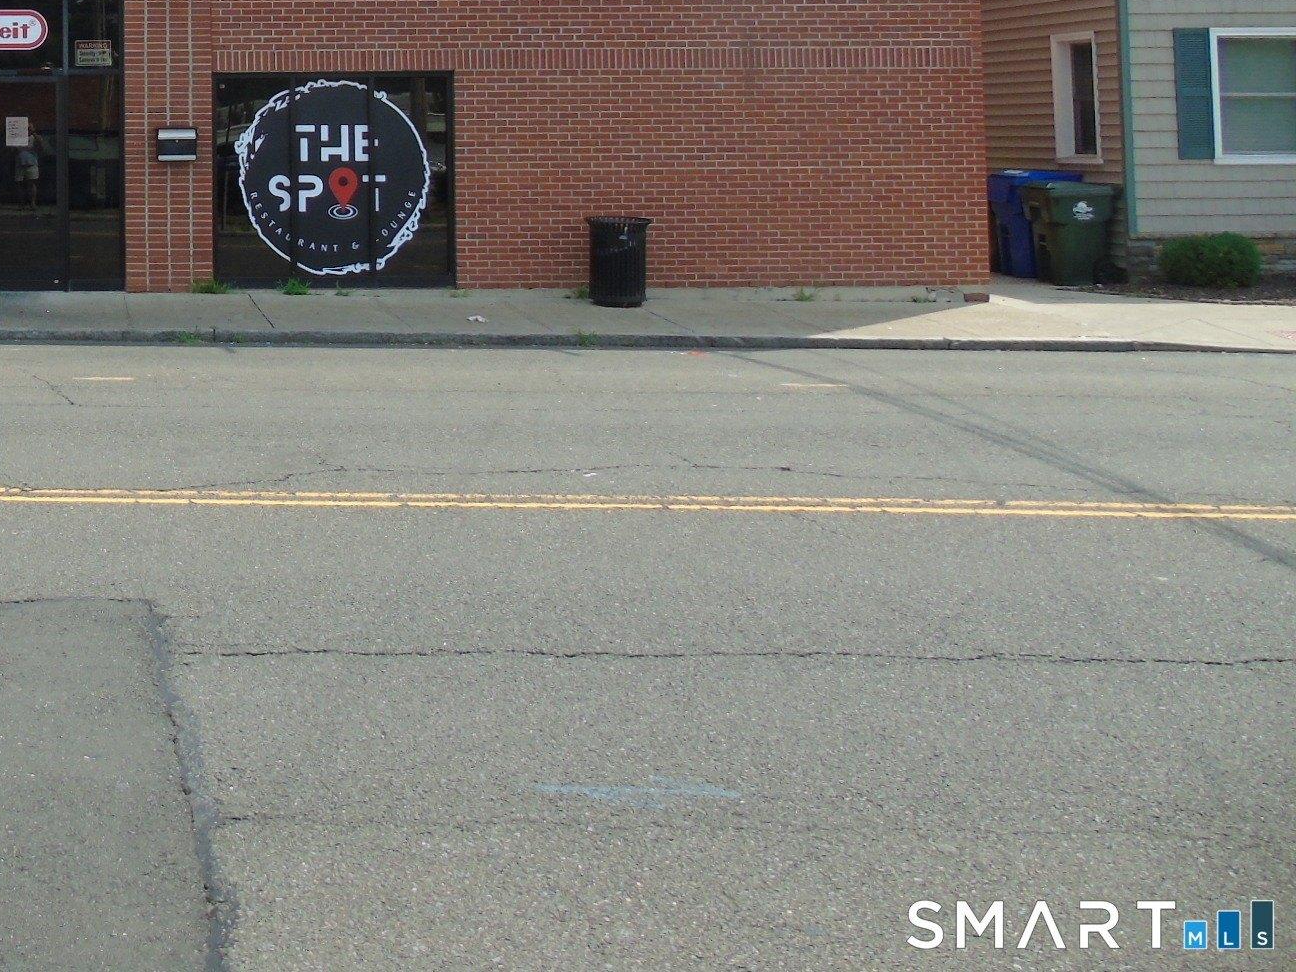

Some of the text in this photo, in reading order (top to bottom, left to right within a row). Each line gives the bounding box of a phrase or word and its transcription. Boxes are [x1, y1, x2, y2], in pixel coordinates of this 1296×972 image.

[295, 124, 378, 162] THE
[351, 241, 360, 250] &
[375, 190, 416, 242] OUNGE
